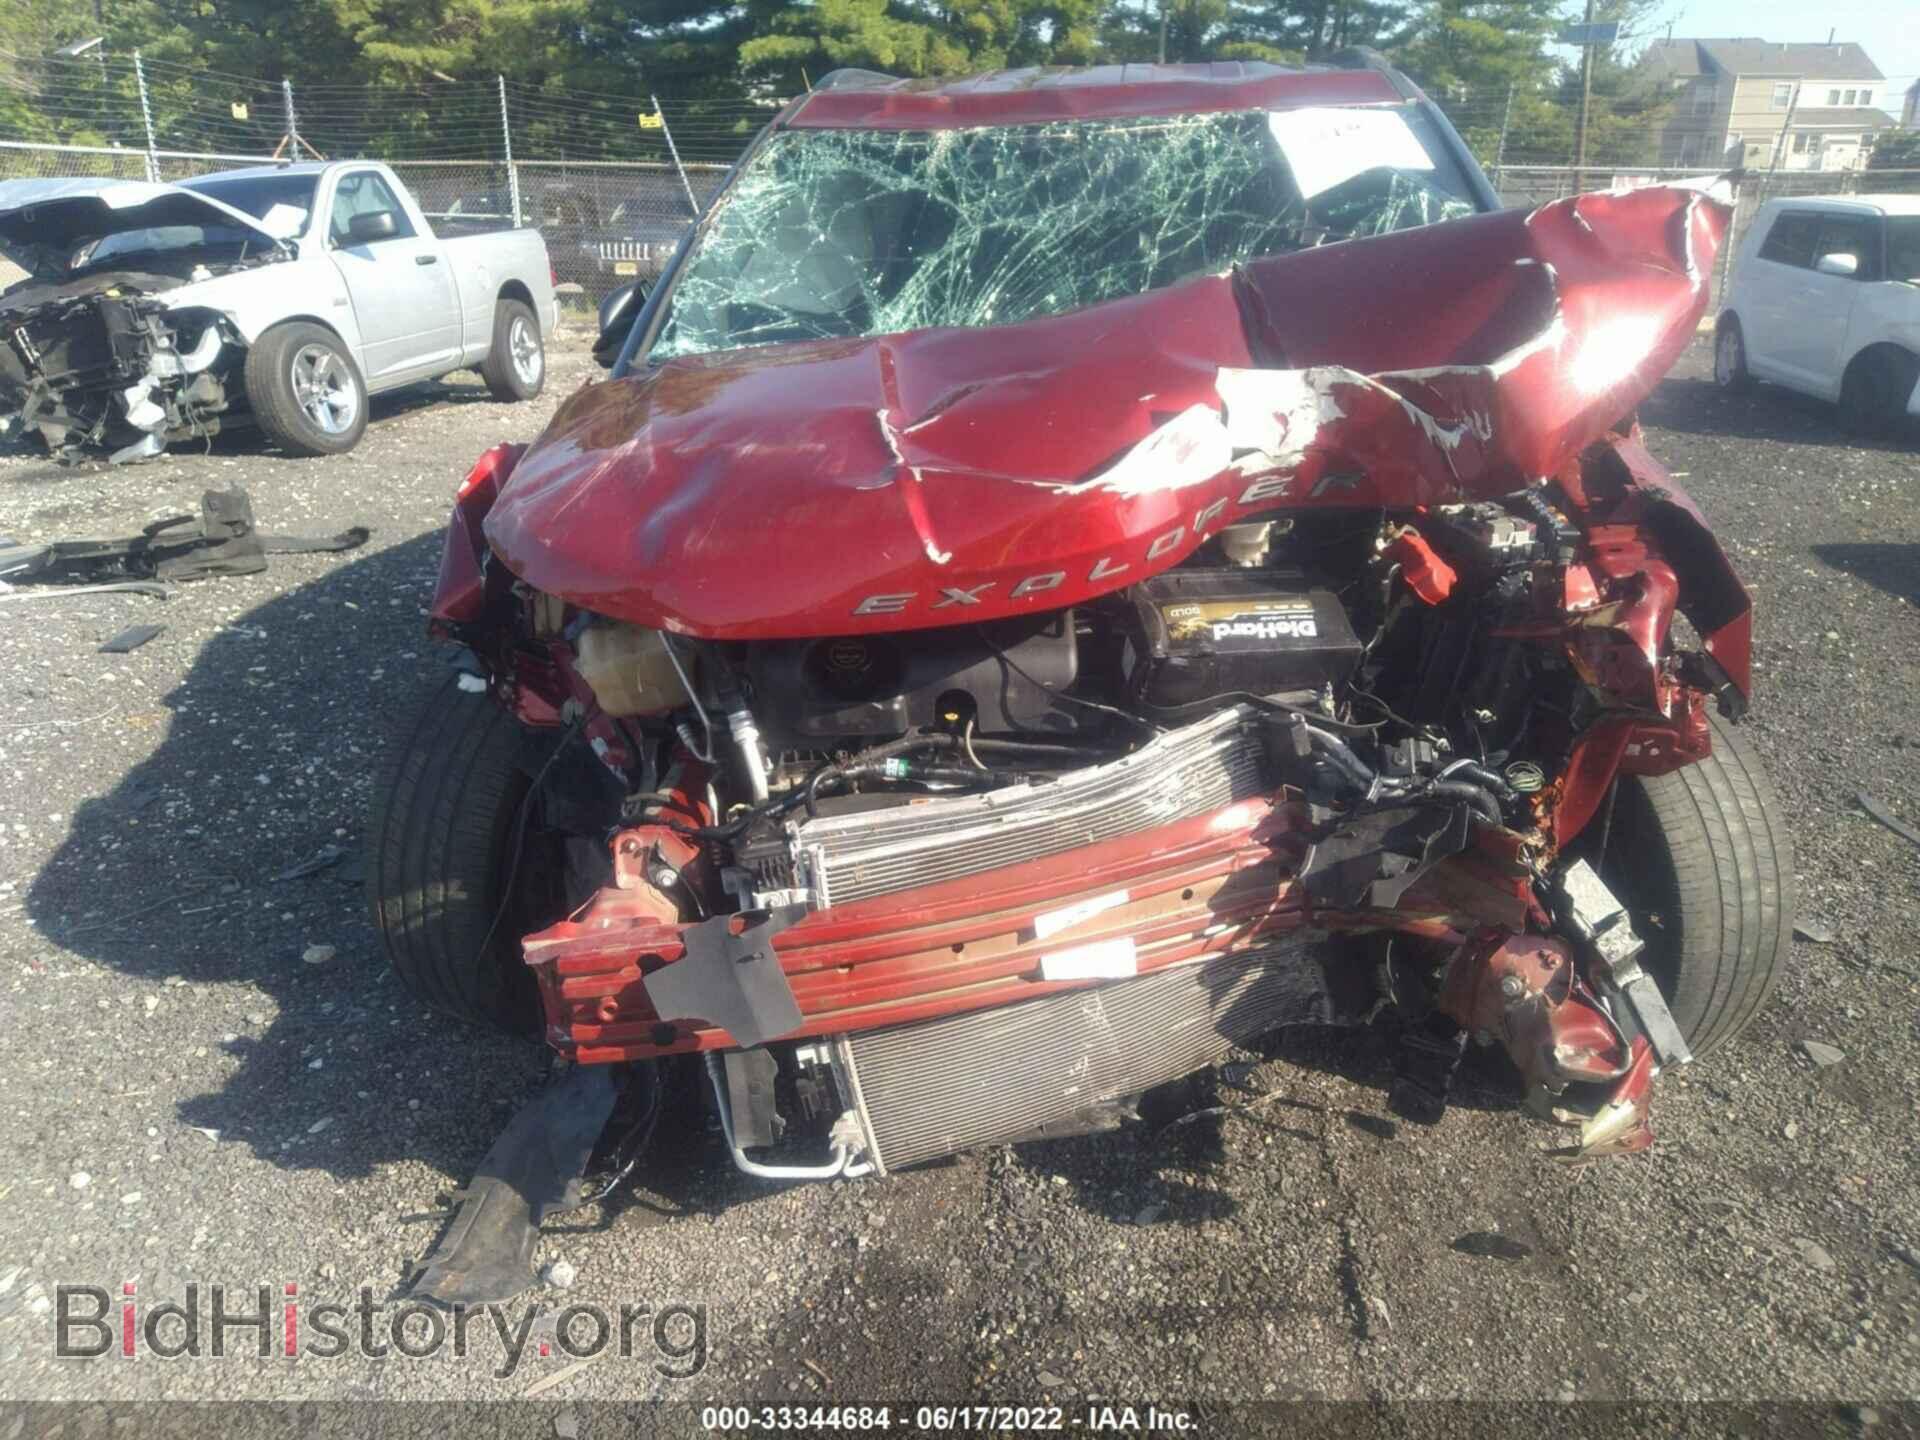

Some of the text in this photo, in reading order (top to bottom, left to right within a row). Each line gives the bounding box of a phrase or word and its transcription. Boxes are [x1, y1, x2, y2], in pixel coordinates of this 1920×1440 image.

[854, 473, 1366, 617] EXPLORER
[1170, 606, 1200, 617] GOLD
[1213, 620, 1317, 640] DieHard
